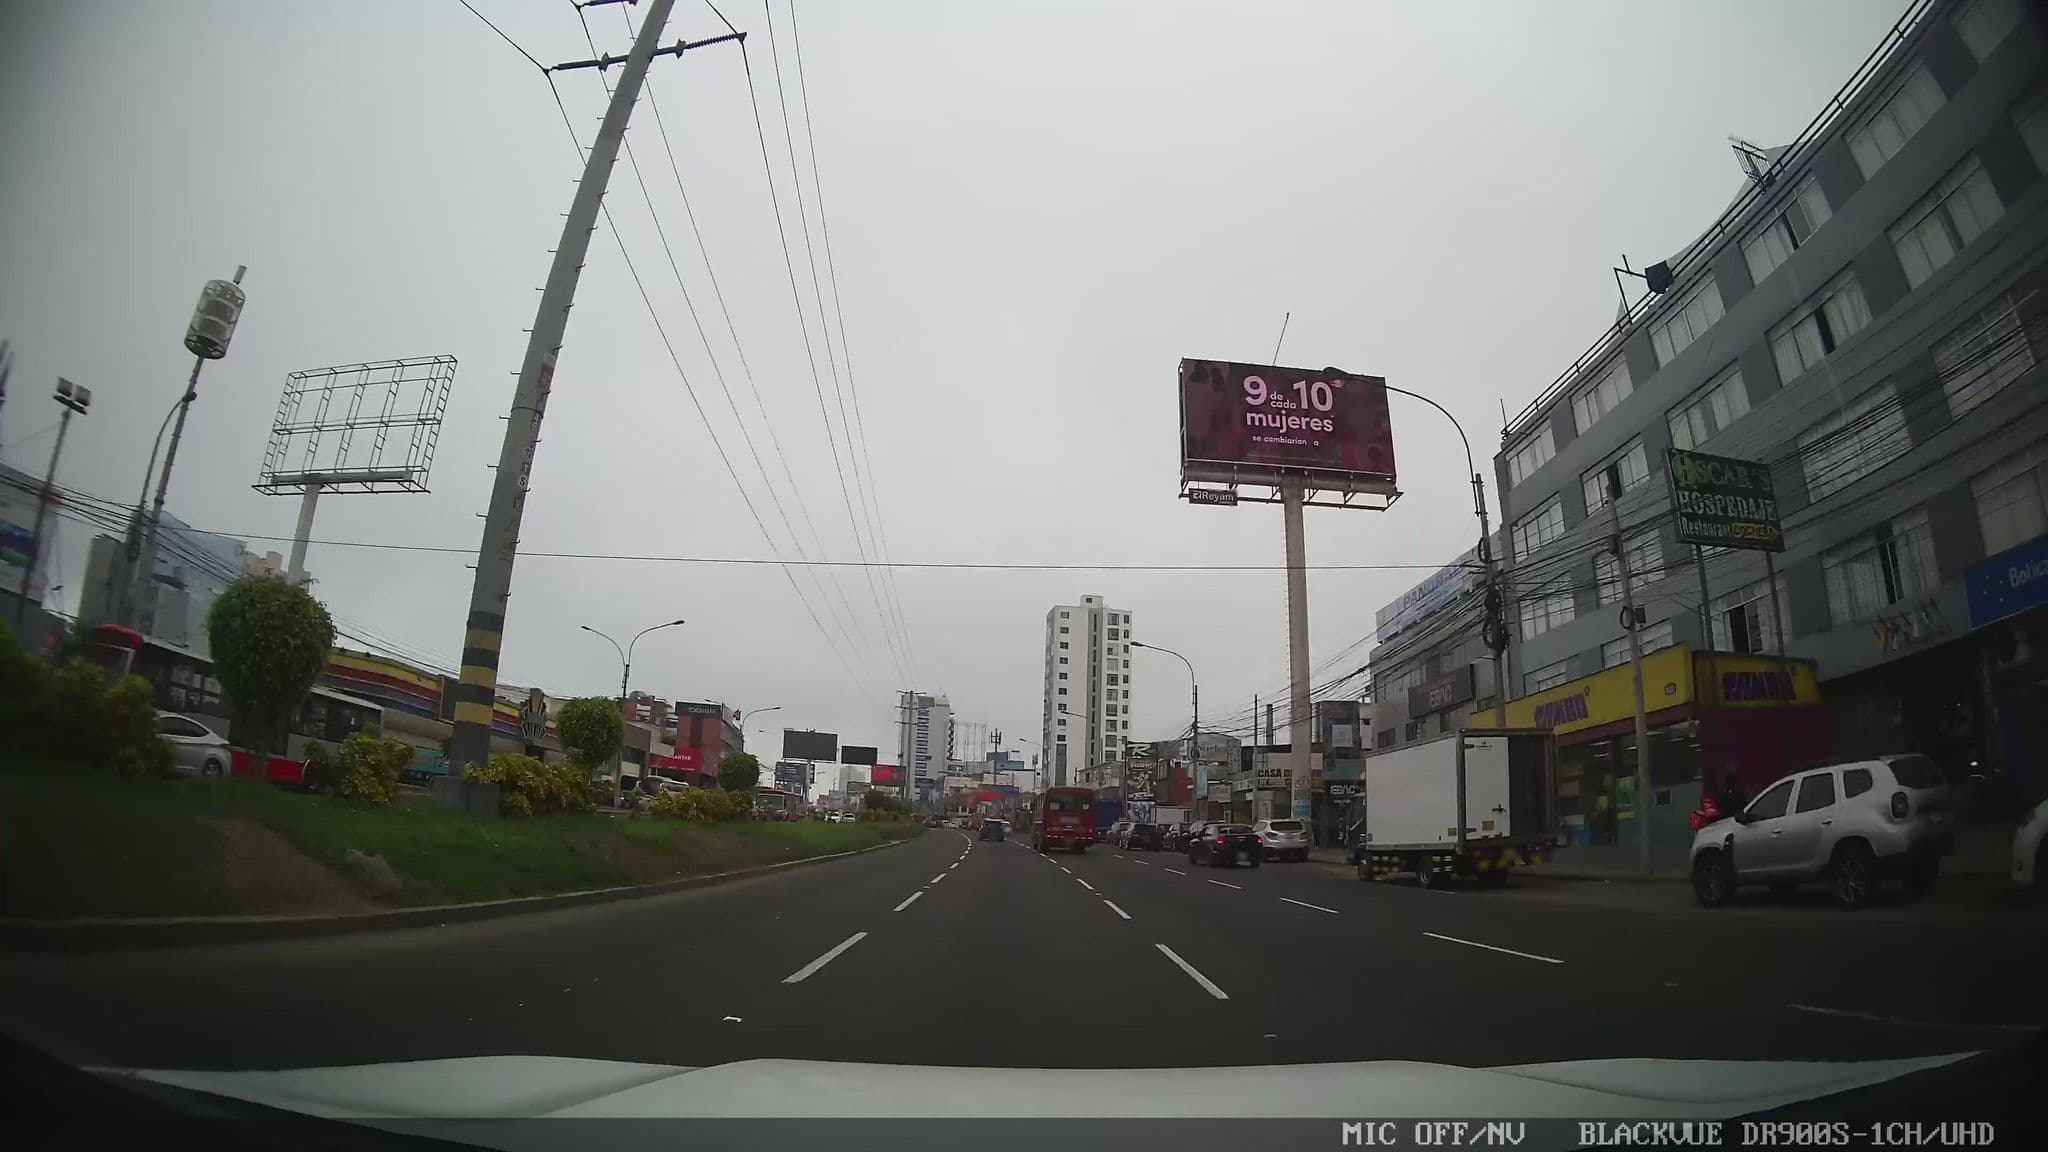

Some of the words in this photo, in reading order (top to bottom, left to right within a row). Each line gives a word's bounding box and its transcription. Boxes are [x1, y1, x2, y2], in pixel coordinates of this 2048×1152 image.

[1243, 375, 1267, 406] 9
[1269, 390, 1284, 401] de
[1293, 379, 1334, 412] 10
[1270, 399, 1297, 410] cada
[1246, 410, 1334, 433] mujeres
[1257, 768, 1282, 778] CASA
